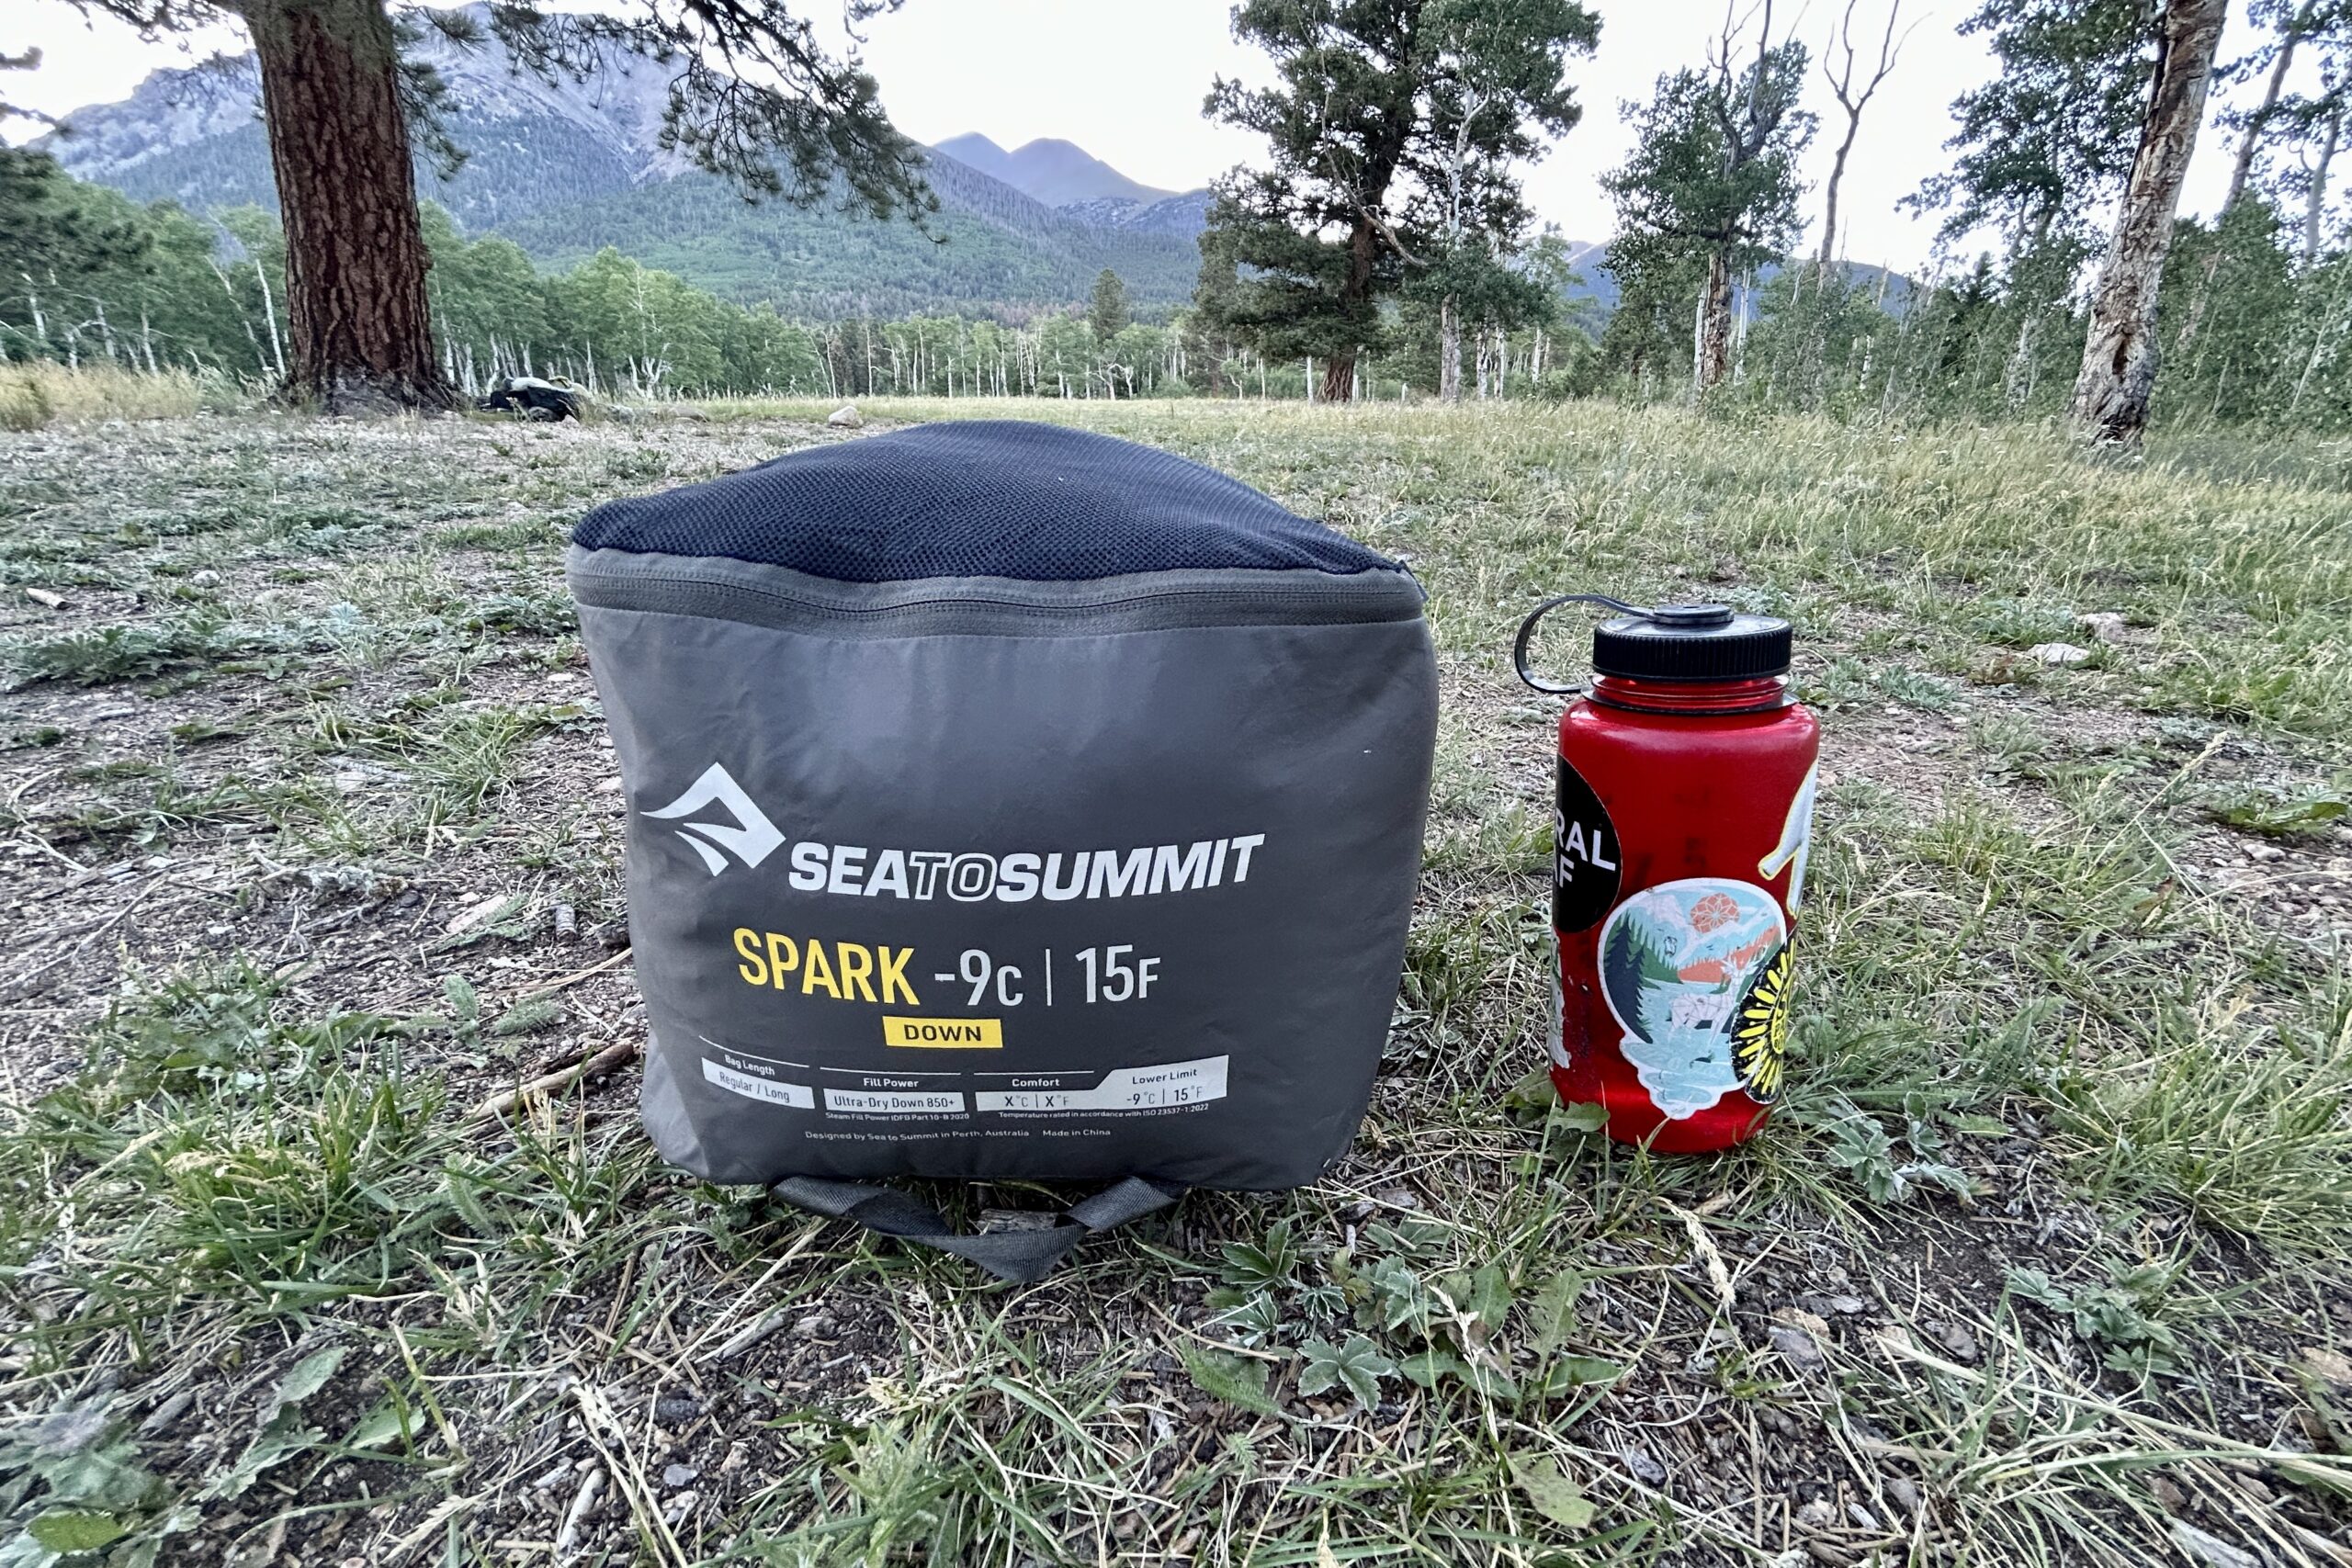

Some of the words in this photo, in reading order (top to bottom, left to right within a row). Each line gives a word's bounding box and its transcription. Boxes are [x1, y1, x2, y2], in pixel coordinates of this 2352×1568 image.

[733, 927, 920, 1006] SPARK
[1075, 944, 1161, 1004] 15F
[903, 1024, 982, 1042] DOWN
[725, 1055, 741, 1068] Bag
[743, 1060, 775, 1076] Length
[864, 1077, 881, 1087] Fill
[883, 1078, 919, 1088] Power
[1012, 1078, 1059, 1088] Comfort
[1133, 1073, 1167, 1085] Lower
[1170, 1068, 1197, 1080] Limit
[719, 1071, 752, 1091] Regular
[765, 1086, 790, 1102] Long
[834, 1096, 888, 1110] Ultra-Dry
[892, 1097, 923, 1108] Down
[927, 1098, 955, 1108] 850+
[805, 1131, 852, 1141] Designed
[900, 1133, 939, 1141] Summit
